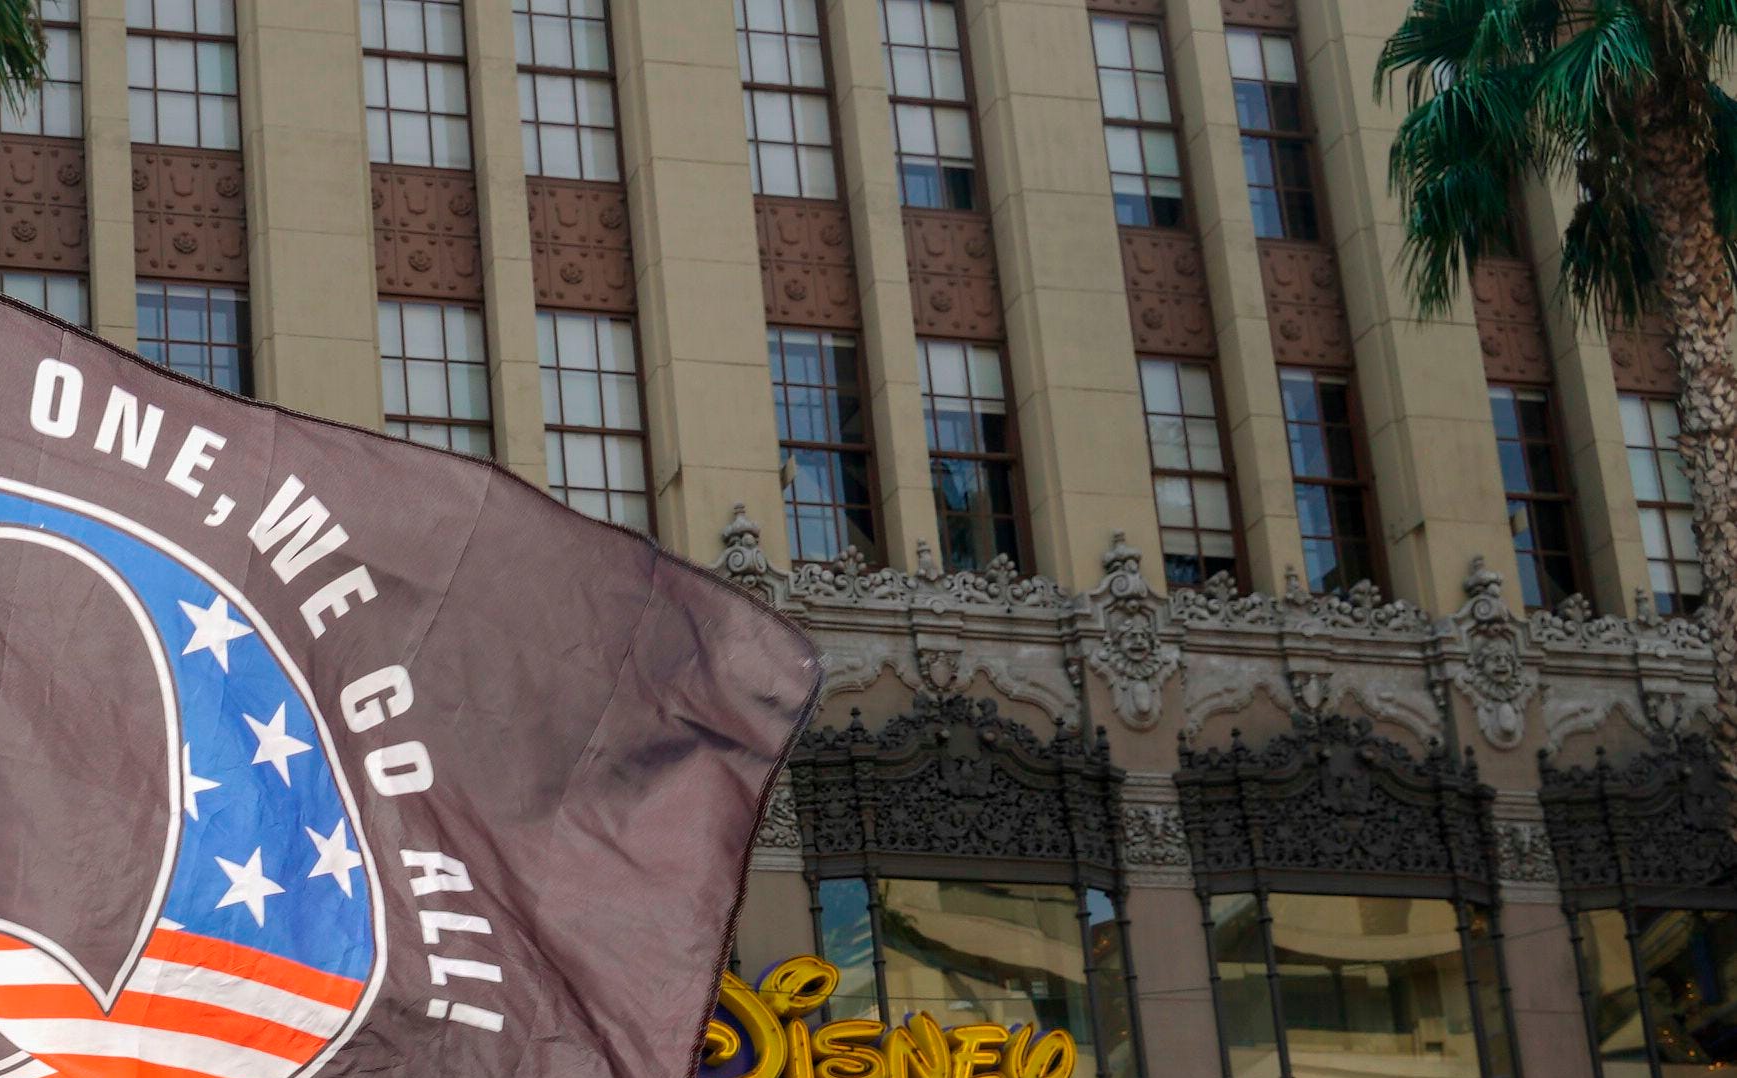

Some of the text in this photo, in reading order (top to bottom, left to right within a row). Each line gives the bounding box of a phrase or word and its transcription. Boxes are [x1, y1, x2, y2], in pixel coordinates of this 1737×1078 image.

[30, 358, 236, 527] ONE,
[247, 474, 379, 639] WE
[340, 664, 434, 797] GO
[400, 847, 505, 1032] ALL!
